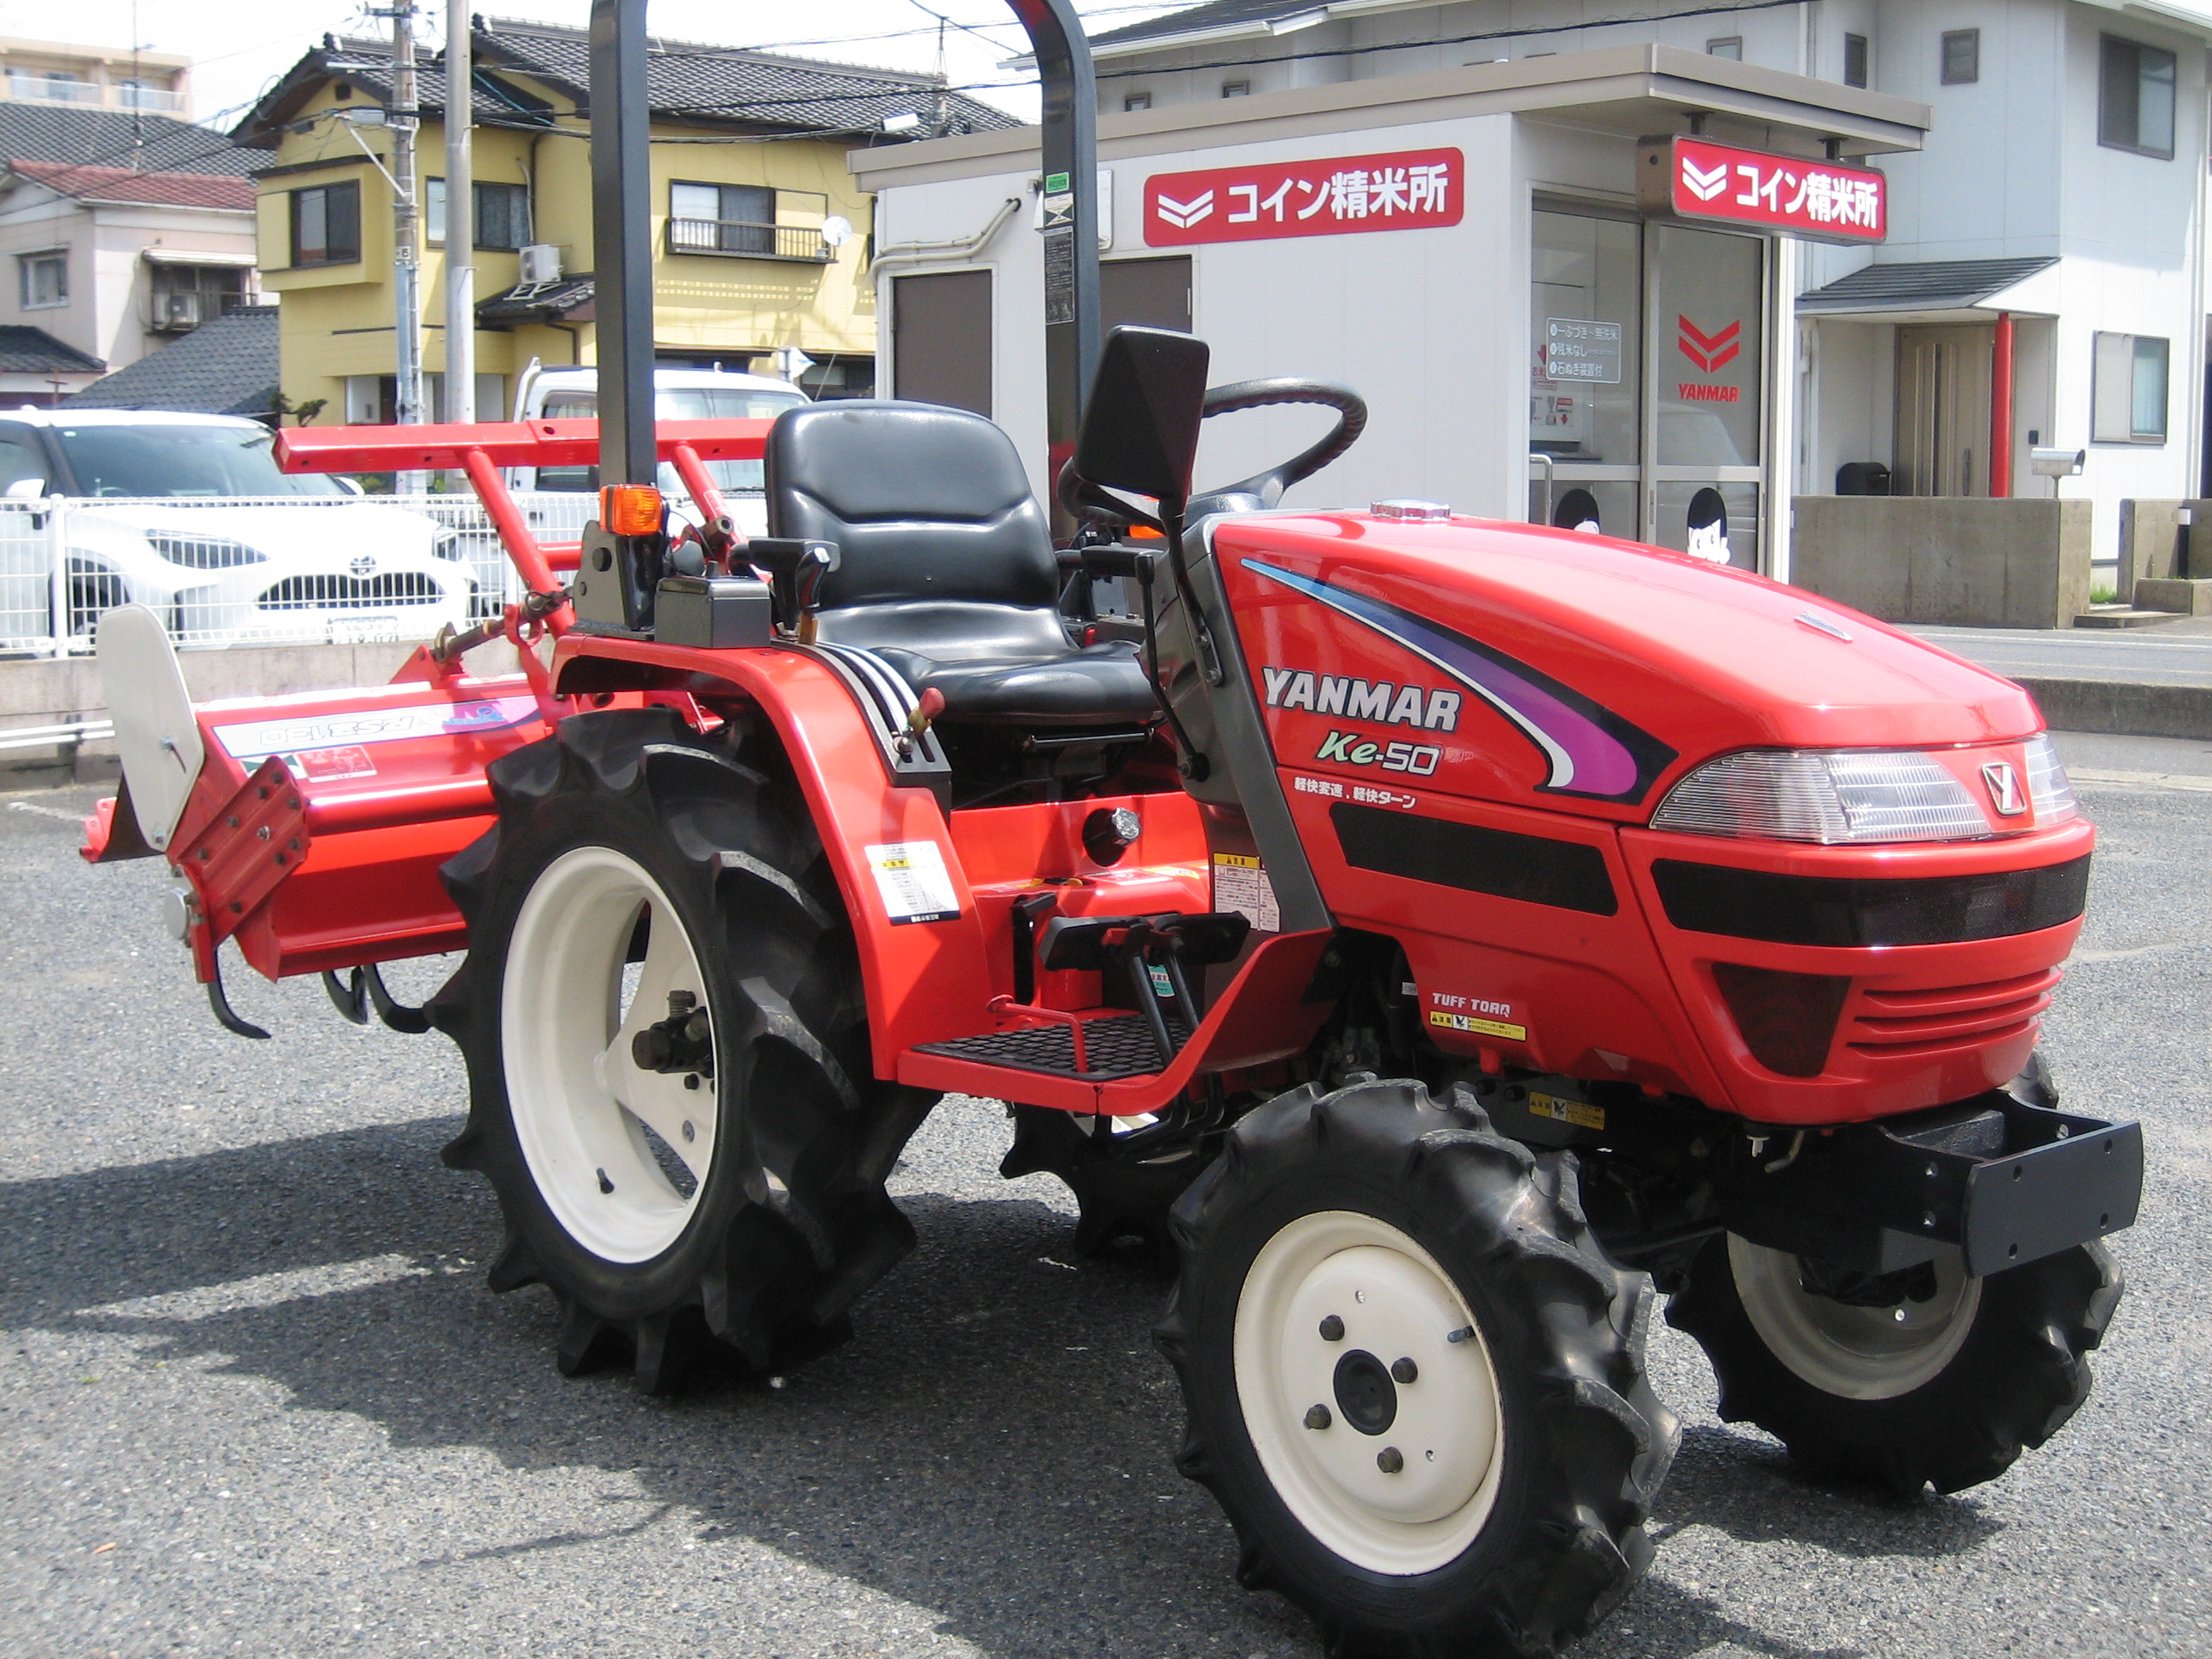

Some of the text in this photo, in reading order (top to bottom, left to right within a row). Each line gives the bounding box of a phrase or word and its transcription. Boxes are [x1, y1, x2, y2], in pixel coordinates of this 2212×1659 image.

[1227, 163, 1449, 224] コイン精米所
[1736, 165, 1878, 229] コイン精米所
[1678, 383, 1740, 403] YANMAR
[1261, 667, 1462, 732] YANMAR
[1315, 731, 1441, 777] Ke-50
[1432, 992, 1511, 1017] TUFF TORQ
